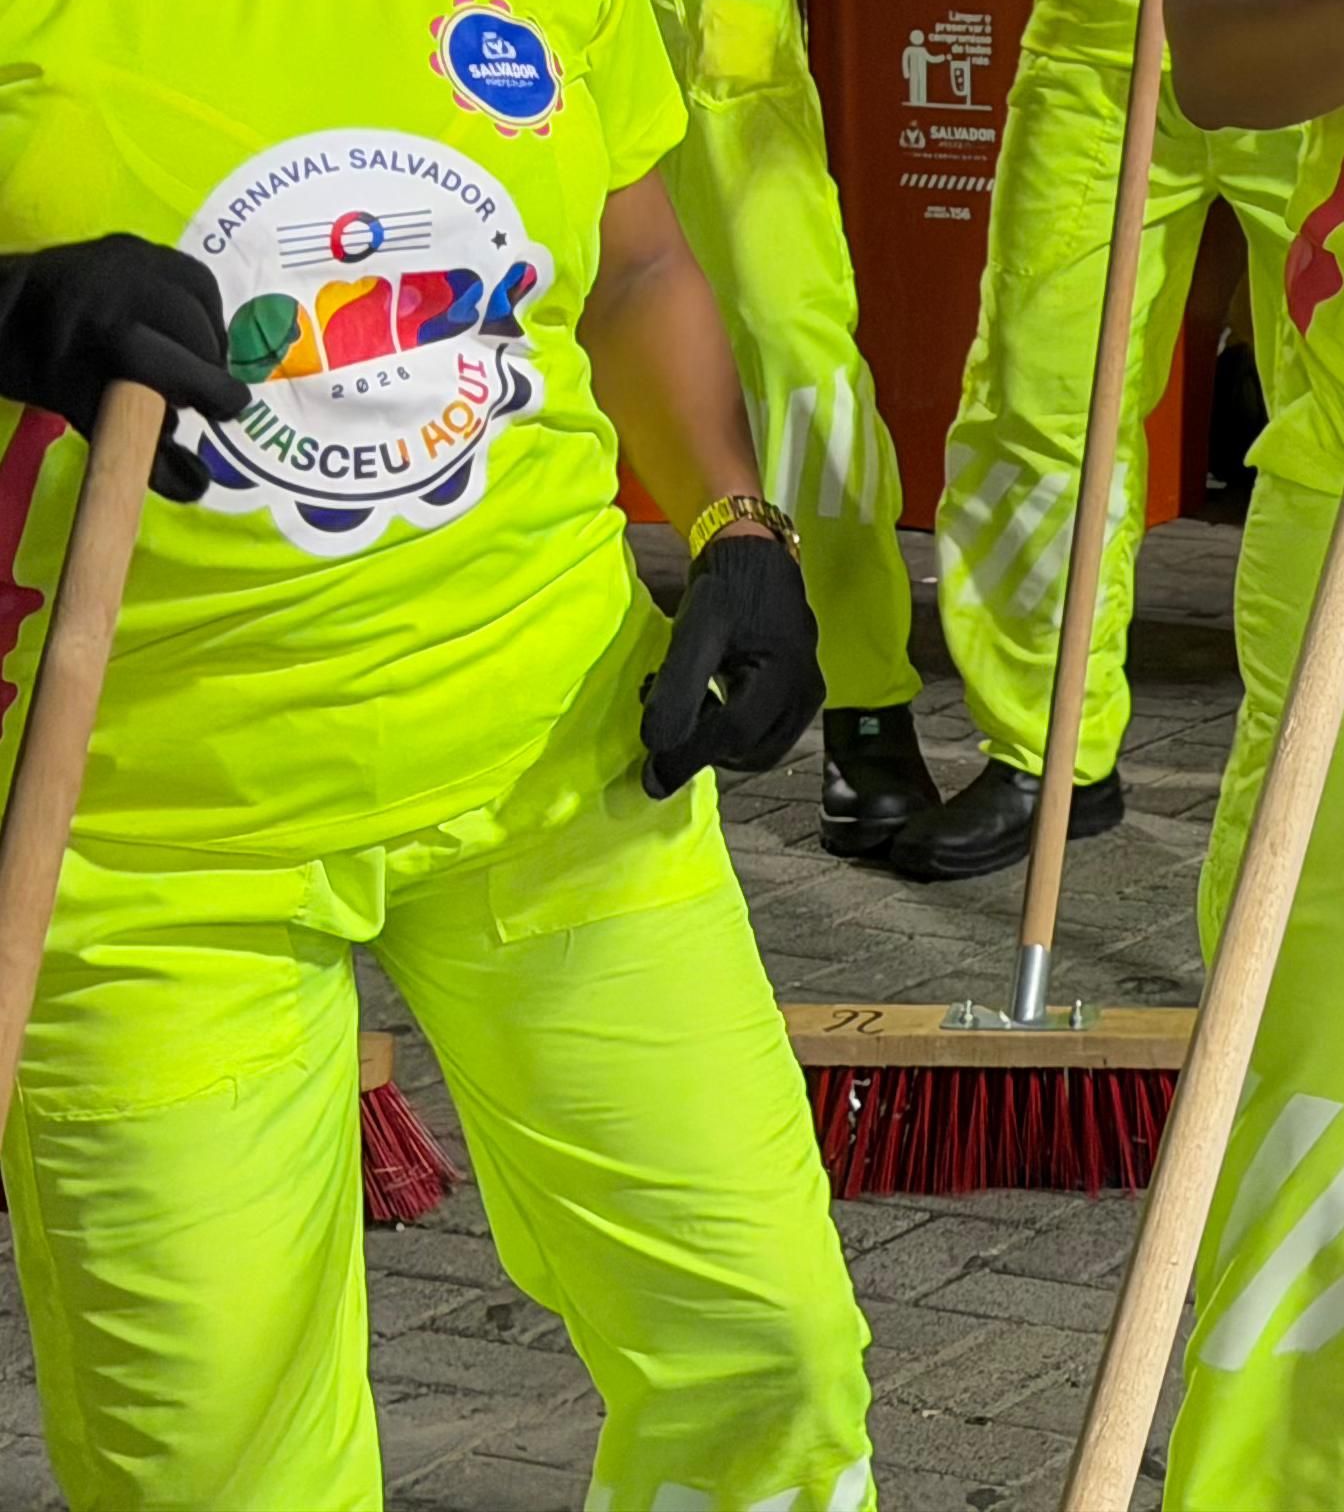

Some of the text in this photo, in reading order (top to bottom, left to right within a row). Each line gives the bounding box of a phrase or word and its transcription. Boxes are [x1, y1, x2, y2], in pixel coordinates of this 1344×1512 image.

[468, 62, 540, 80] SALVADOR
[930, 125, 996, 143] SALVADOR
[203, 147, 498, 257] CARNAVAL SALVADOR
[331, 365, 411, 400] 2026
[238, 352, 490, 481] NASCEU AQUI
